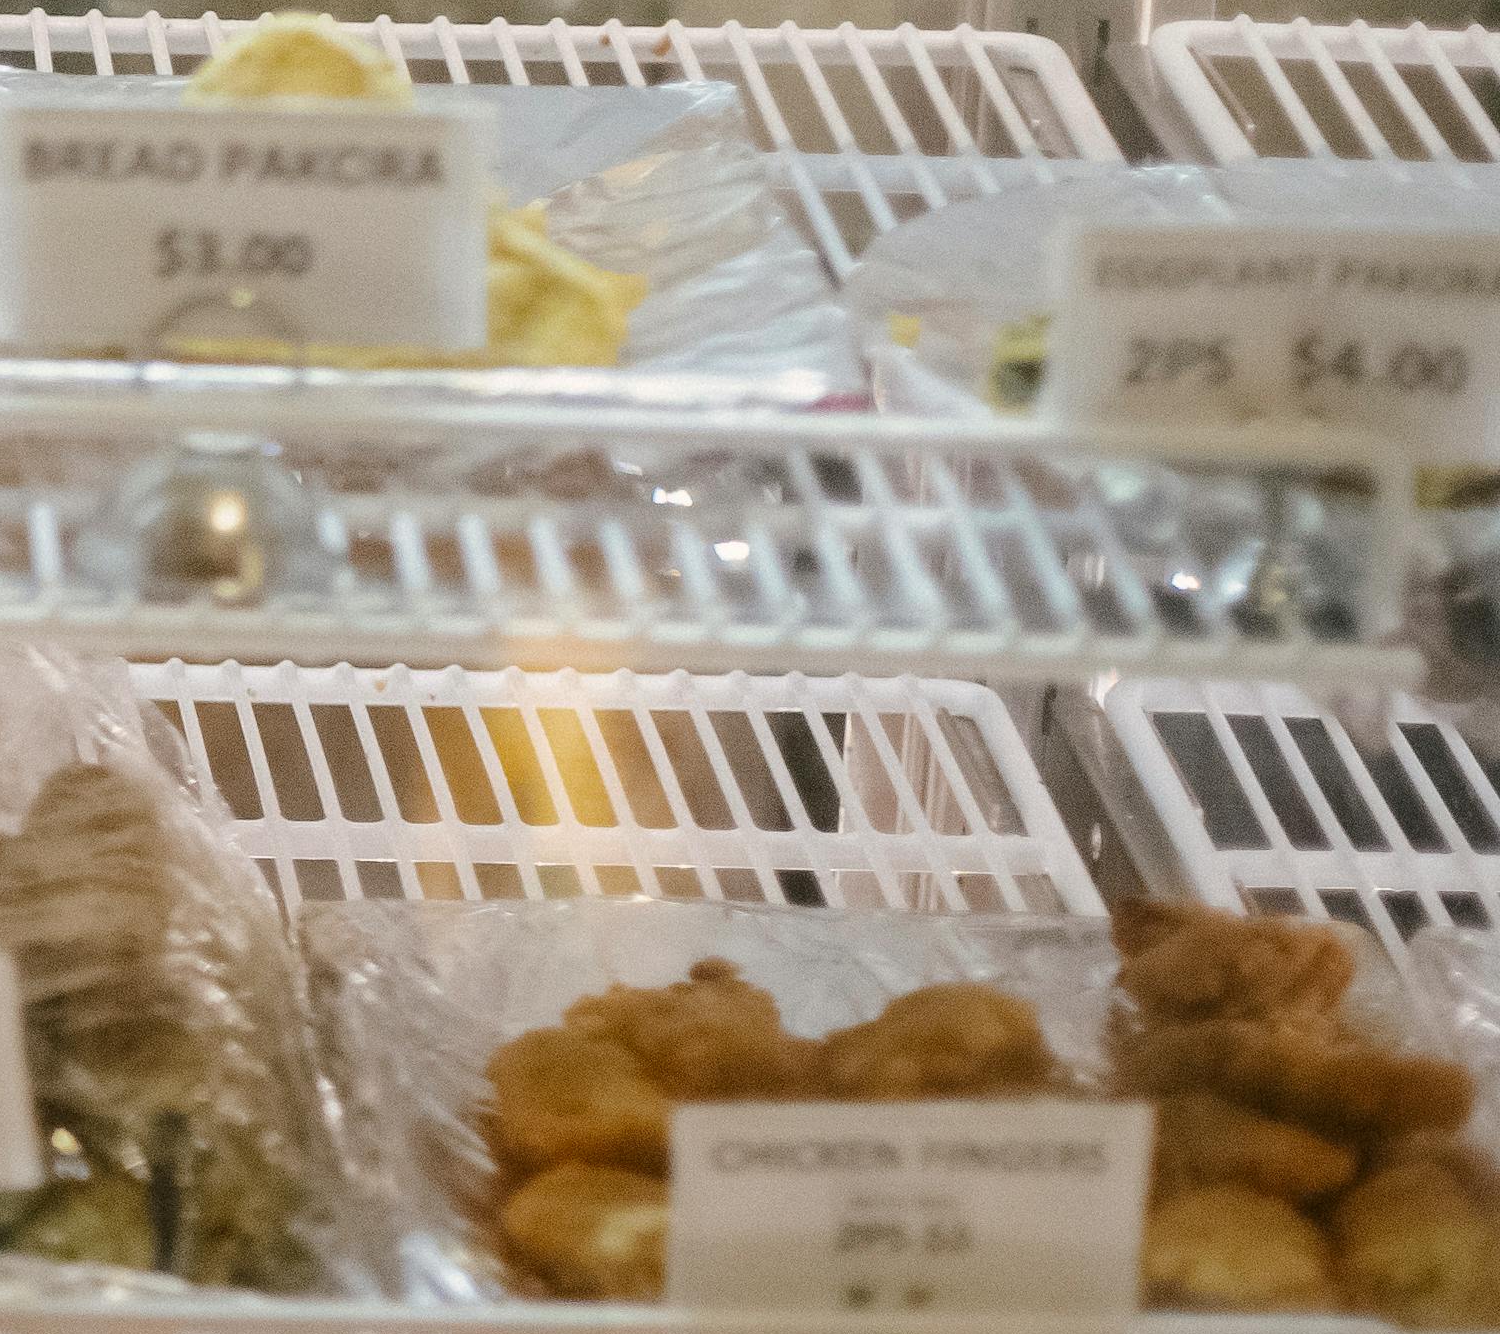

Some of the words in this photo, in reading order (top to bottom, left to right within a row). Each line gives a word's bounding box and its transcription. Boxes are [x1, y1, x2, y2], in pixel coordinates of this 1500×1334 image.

[22, 137, 204, 184] BREAD
[217, 138, 444, 187] PAKORA
[155, 225, 316, 279] $3.00
[1123, 333, 1236, 388] 2PS
[1291, 327, 1471, 396] $4.00
